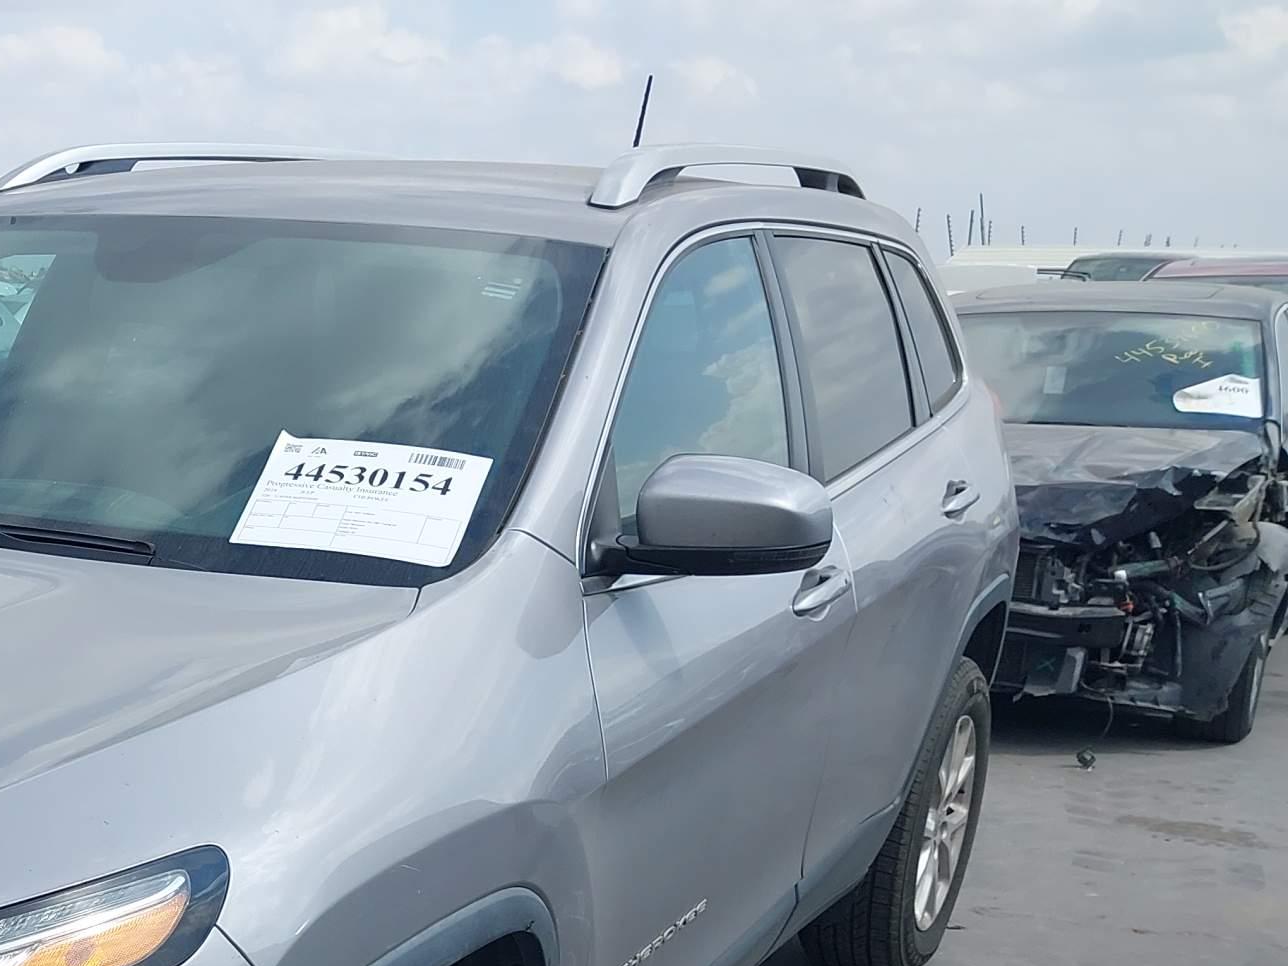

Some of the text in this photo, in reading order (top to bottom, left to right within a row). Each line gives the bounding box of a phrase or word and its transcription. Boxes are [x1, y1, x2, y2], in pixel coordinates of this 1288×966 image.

[266, 479, 315, 489] Progressive
[316, 483, 355, 493] Casualty
[355, 486, 399, 497] Insurance
[284, 461, 453, 496] 44530154
